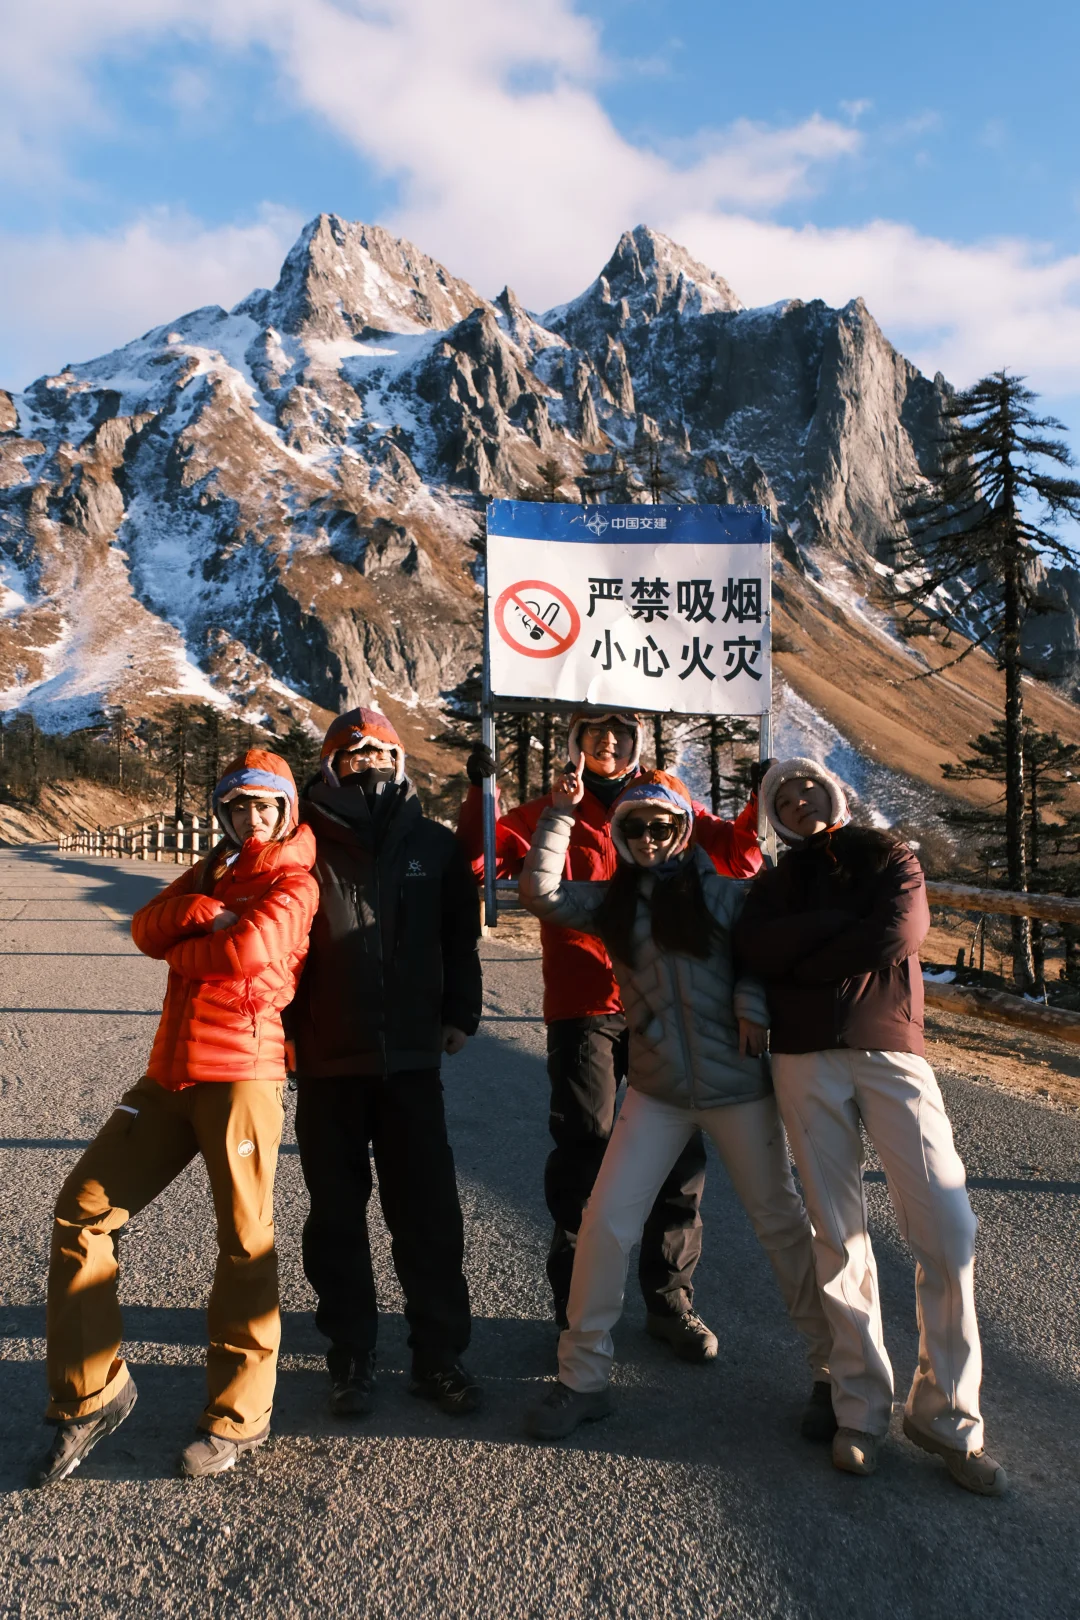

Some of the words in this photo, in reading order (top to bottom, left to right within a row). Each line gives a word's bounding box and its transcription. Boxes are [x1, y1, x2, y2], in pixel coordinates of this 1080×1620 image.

[611, 516, 668, 530] 中国交建
[586, 576, 763, 624] 严禁吸烟
[590, 629, 763, 682] 小心火灾
